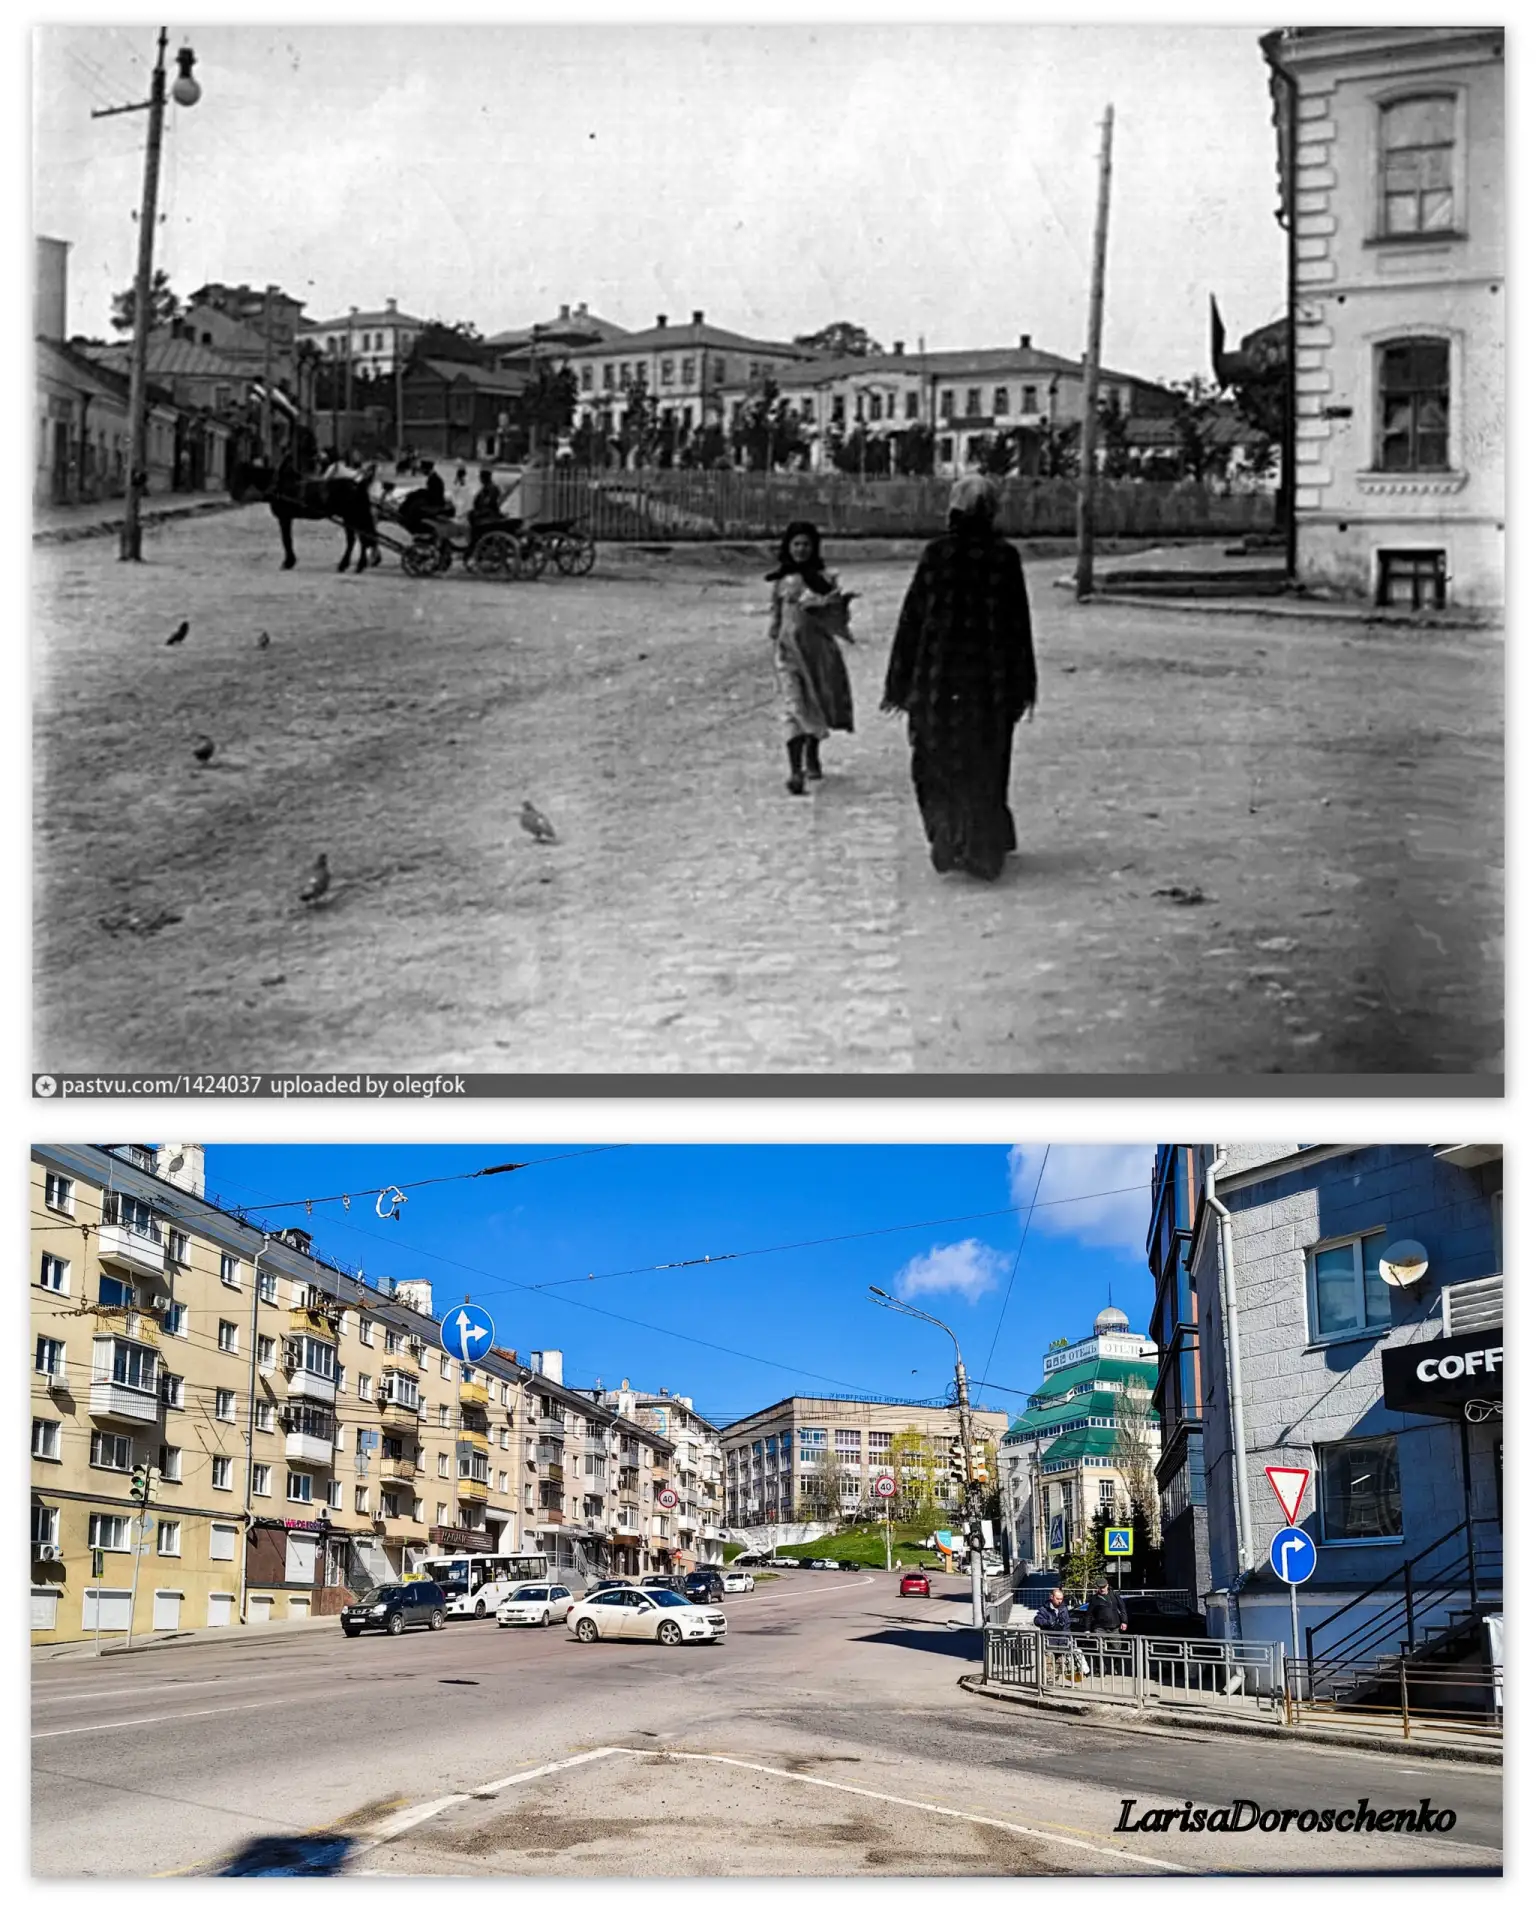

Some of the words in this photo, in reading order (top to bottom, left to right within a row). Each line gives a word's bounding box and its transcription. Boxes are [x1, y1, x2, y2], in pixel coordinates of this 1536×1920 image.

[1068, 1344, 1097, 1361] ОТЕЛЬ
[1416, 1347, 1503, 1382] COFF
[880, 1483, 892, 1491] 40
[662, 1495, 673, 1503] 40
